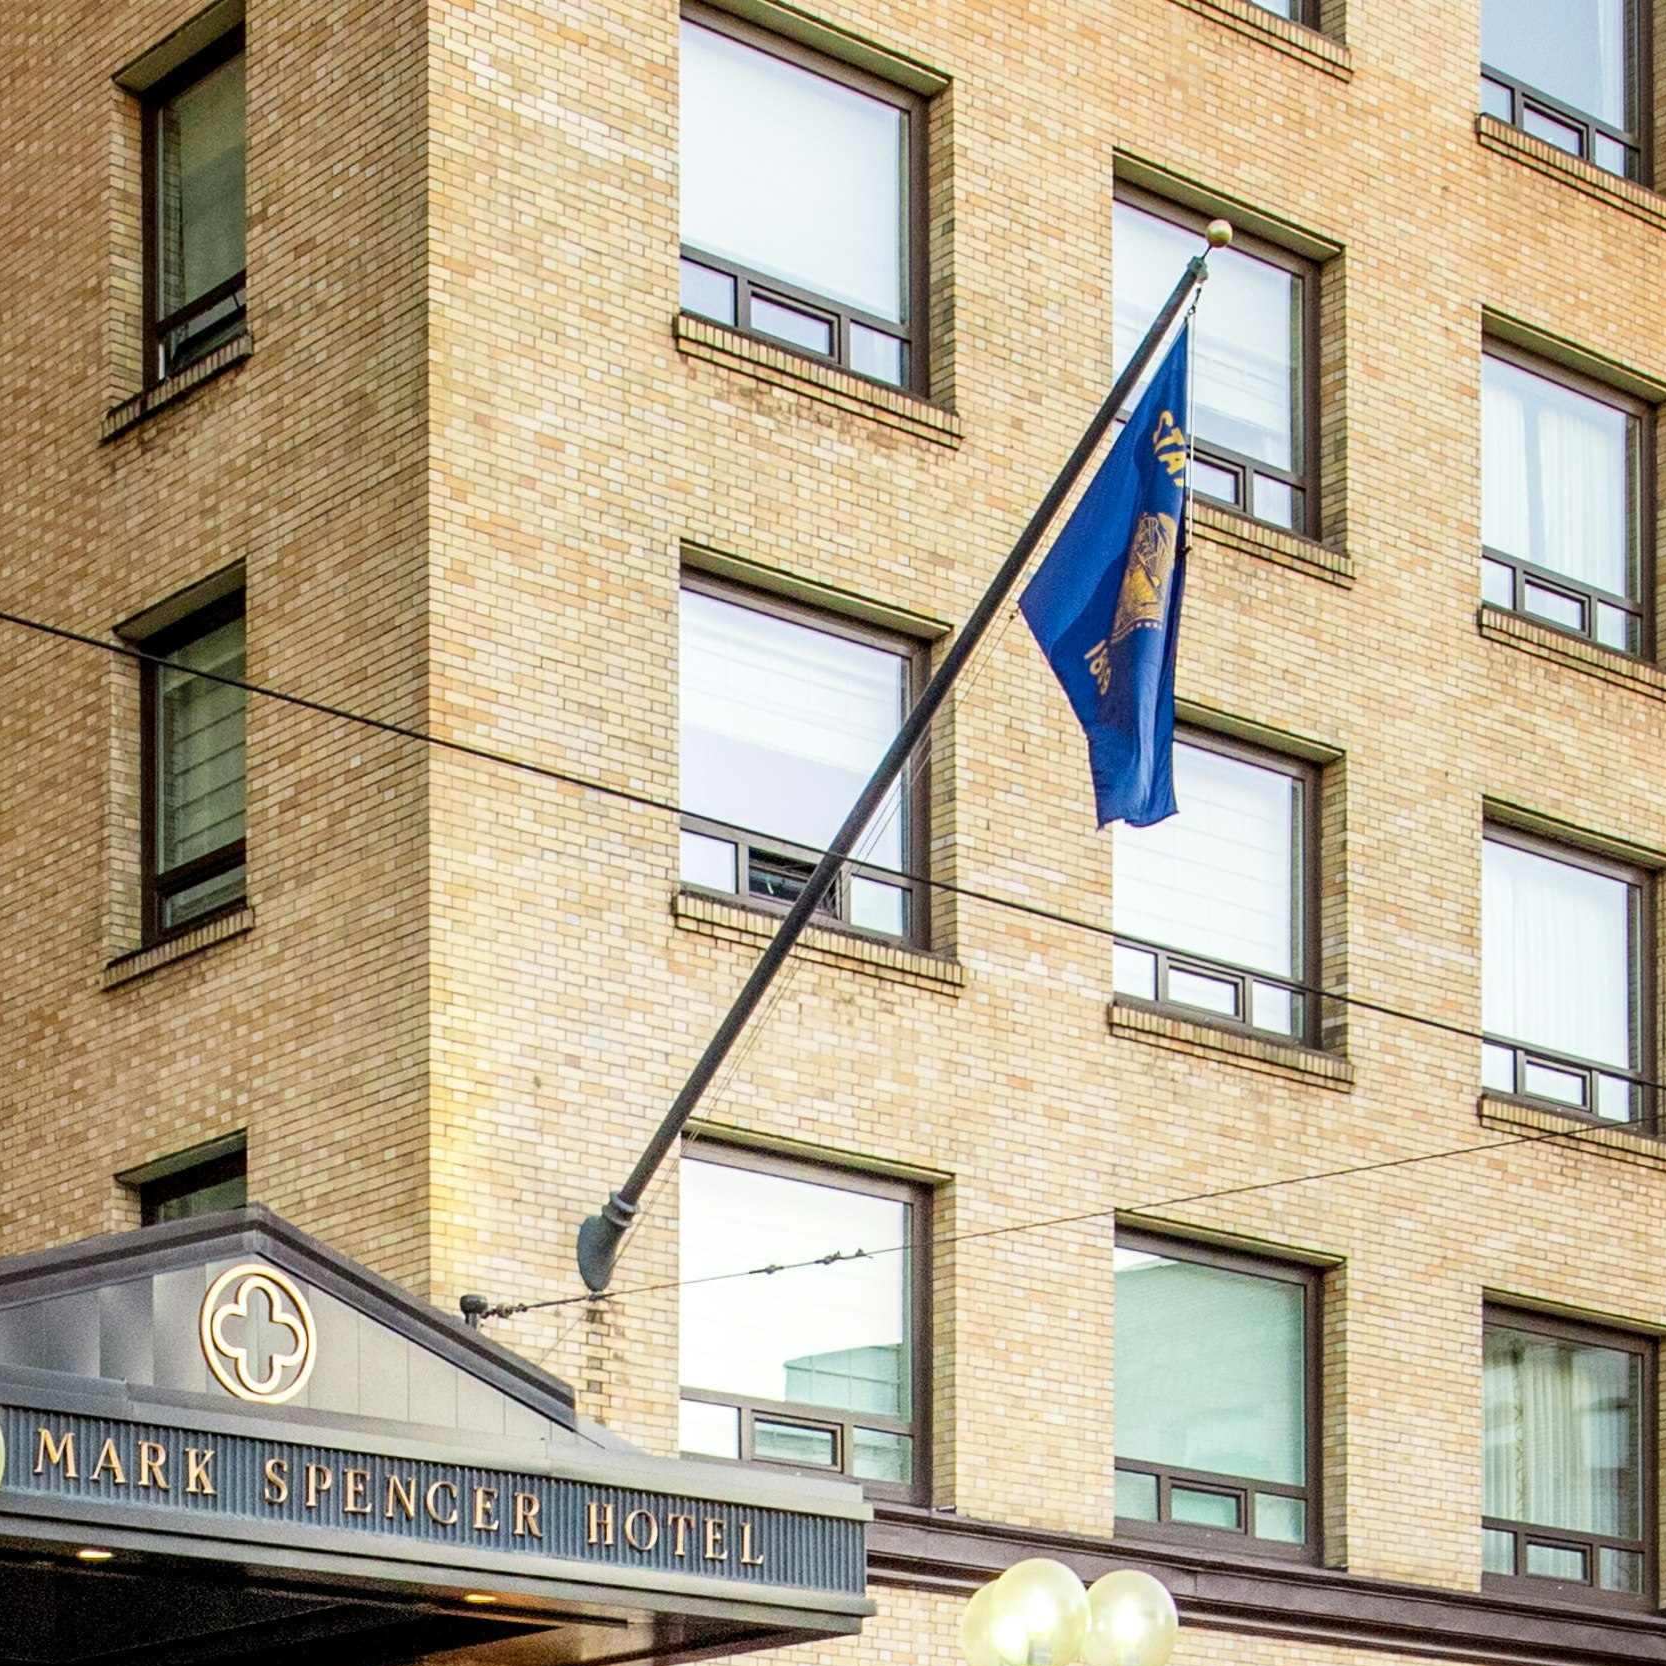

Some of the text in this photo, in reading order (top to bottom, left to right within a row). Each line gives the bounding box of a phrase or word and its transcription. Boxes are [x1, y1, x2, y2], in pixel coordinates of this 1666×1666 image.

[33, 1427, 765, 1566] MARK SPENCER HOTEL
